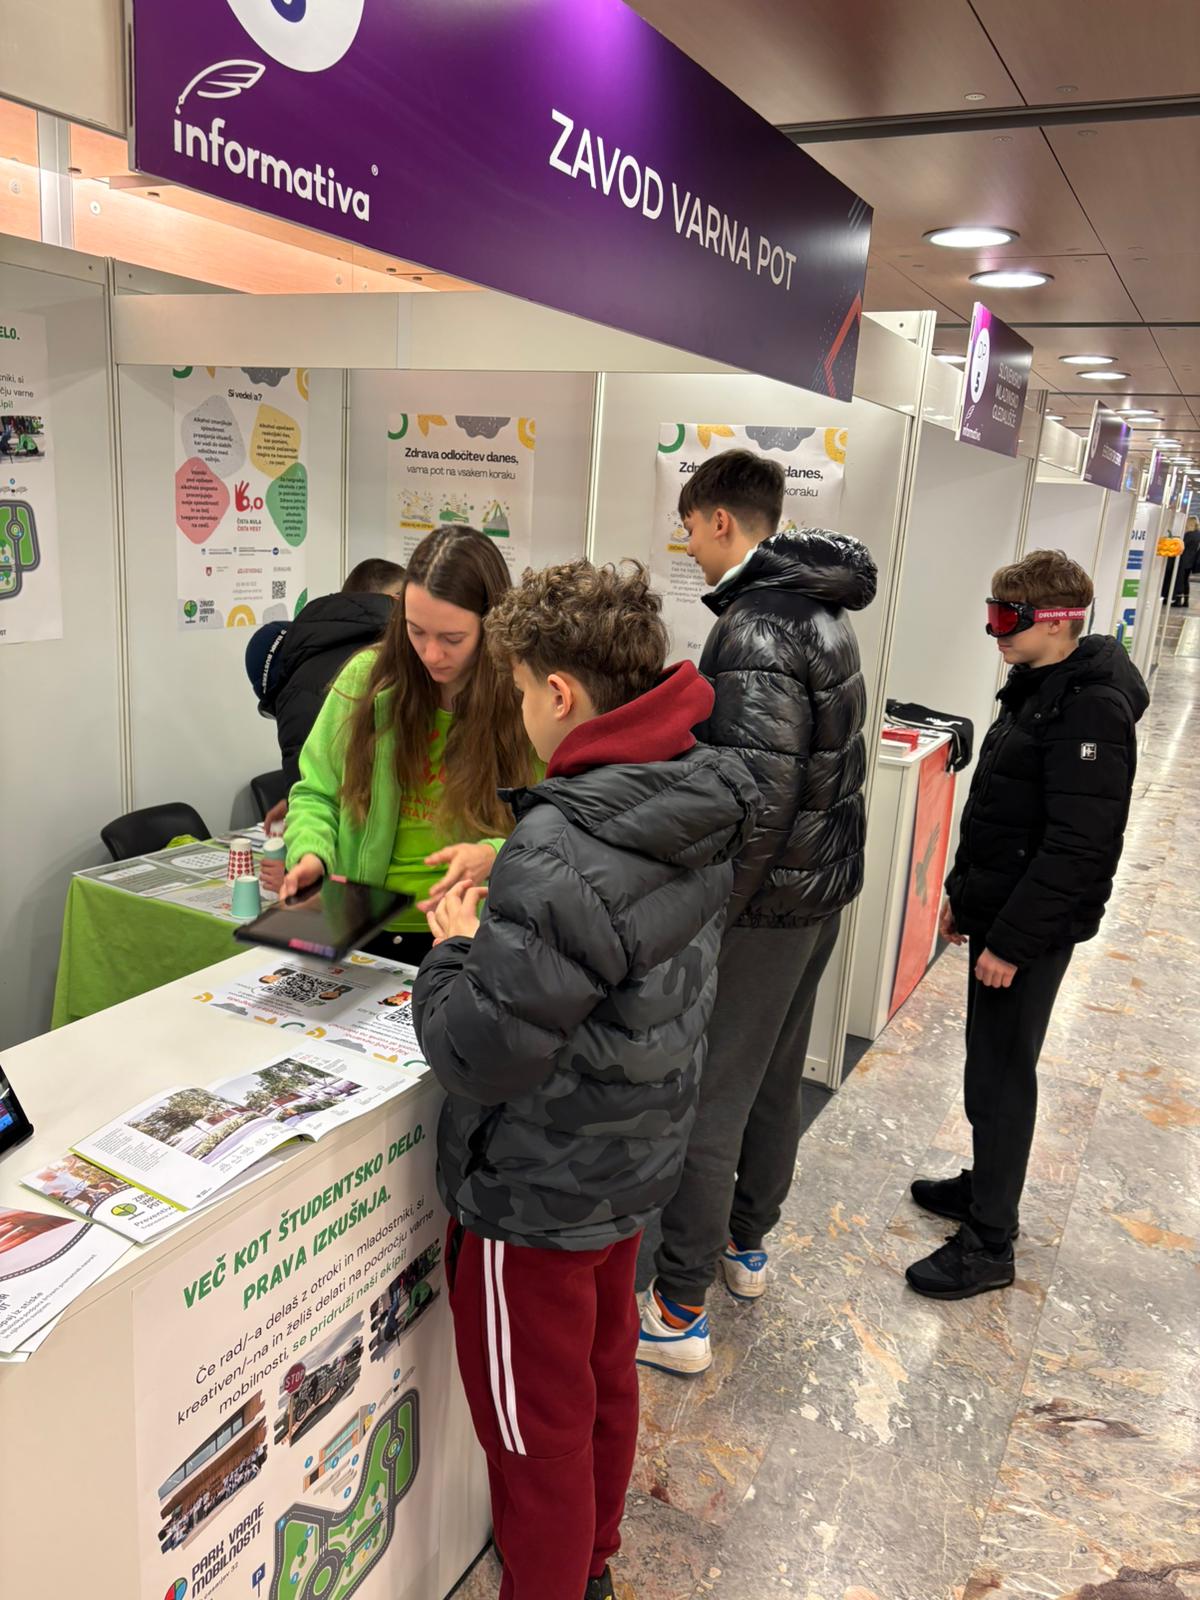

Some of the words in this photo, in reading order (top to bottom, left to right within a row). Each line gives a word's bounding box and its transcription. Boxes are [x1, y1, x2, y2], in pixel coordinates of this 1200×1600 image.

[174, 117, 370, 222] informativa
[549, 108, 664, 220] ZAVOD
[672, 182, 751, 270] VARNA
[756, 236, 796, 290] POT
[0, 326, 20, 340] ELO.
[405, 448, 439, 460] Zdrava
[441, 449, 484, 462] odločitev
[486, 451, 519, 465] danes,
[430, 467, 444, 477] pot
[446, 467, 456, 476] na
[458, 467, 488, 478] vsakem
[489, 469, 516, 480] koraku
[182, 1253, 227, 1310] VEČ
[233, 1229, 272, 1276] KOT
[278, 1152, 383, 1243] ŠTUDENTSKO
[388, 1124, 426, 1166] DELO.
[243, 1245, 307, 1311] PRAVA
[312, 1184, 392, 1257] IZKUŠNJA.
[177, 1343, 269, 1426] kreativen/-na
[272, 1328, 283, 1347] in
[286, 1306, 313, 1338] želiš
[315, 1278, 346, 1313] delati
[349, 1271, 362, 1286] na
[364, 1232, 408, 1275] področju
[195, 1360, 216, 1385] Če
[220, 1326, 262, 1368] rad/-a
[265, 1295, 299, 1331] delaš
[301, 1291, 308, 1303] z
[310, 1260, 342, 1295] otroki
[344, 1250, 354, 1267] in
[356, 1204, 416, 1258] mladostniki,
[417, 1195, 424, 1210] si
[218, 1346, 290, 1415] mobilnosti,
[292, 1336, 307, 1352] se
[309, 1292, 355, 1344] pridruži
[356, 1276, 378, 1301] naši
[380, 1248, 408, 1282] ekipi!
[192, 1540, 224, 1582] PARK
[229, 1502, 264, 1545] VARNE
[192, 1519, 261, 1599] MOBILNOSTI
